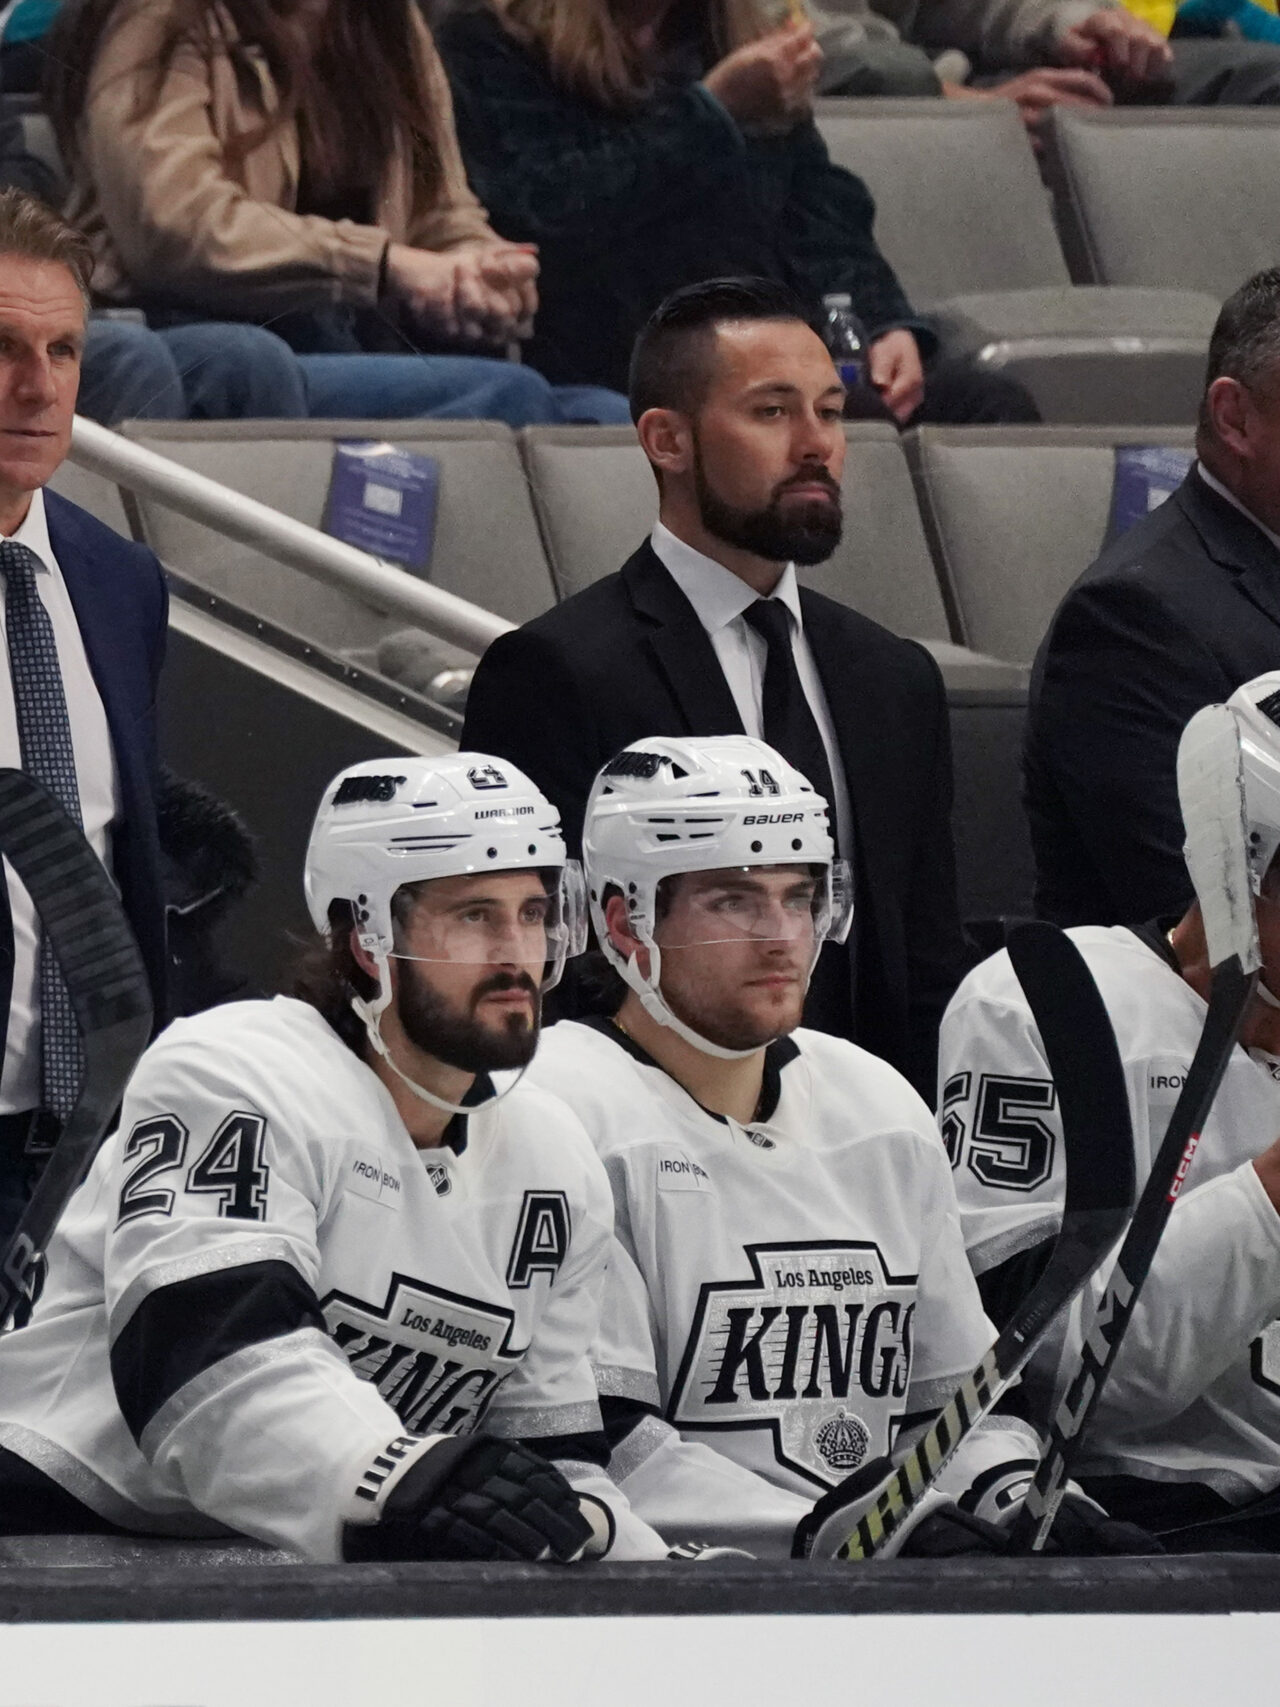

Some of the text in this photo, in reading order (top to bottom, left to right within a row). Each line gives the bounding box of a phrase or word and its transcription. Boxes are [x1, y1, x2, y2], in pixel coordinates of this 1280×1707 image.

[741, 768, 781, 798] 14
[474, 805, 535, 821] WARIOR
[114, 1110, 270, 1234] 24
[352, 1160, 381, 1183] IRON
[660, 1159, 690, 1174] IRON
[1170, 1134, 1199, 1199] CCM
[507, 1190, 572, 1289] A
[775, 1267, 874, 1291] Los Angeles
[400, 1308, 492, 1352] Los Angeles
